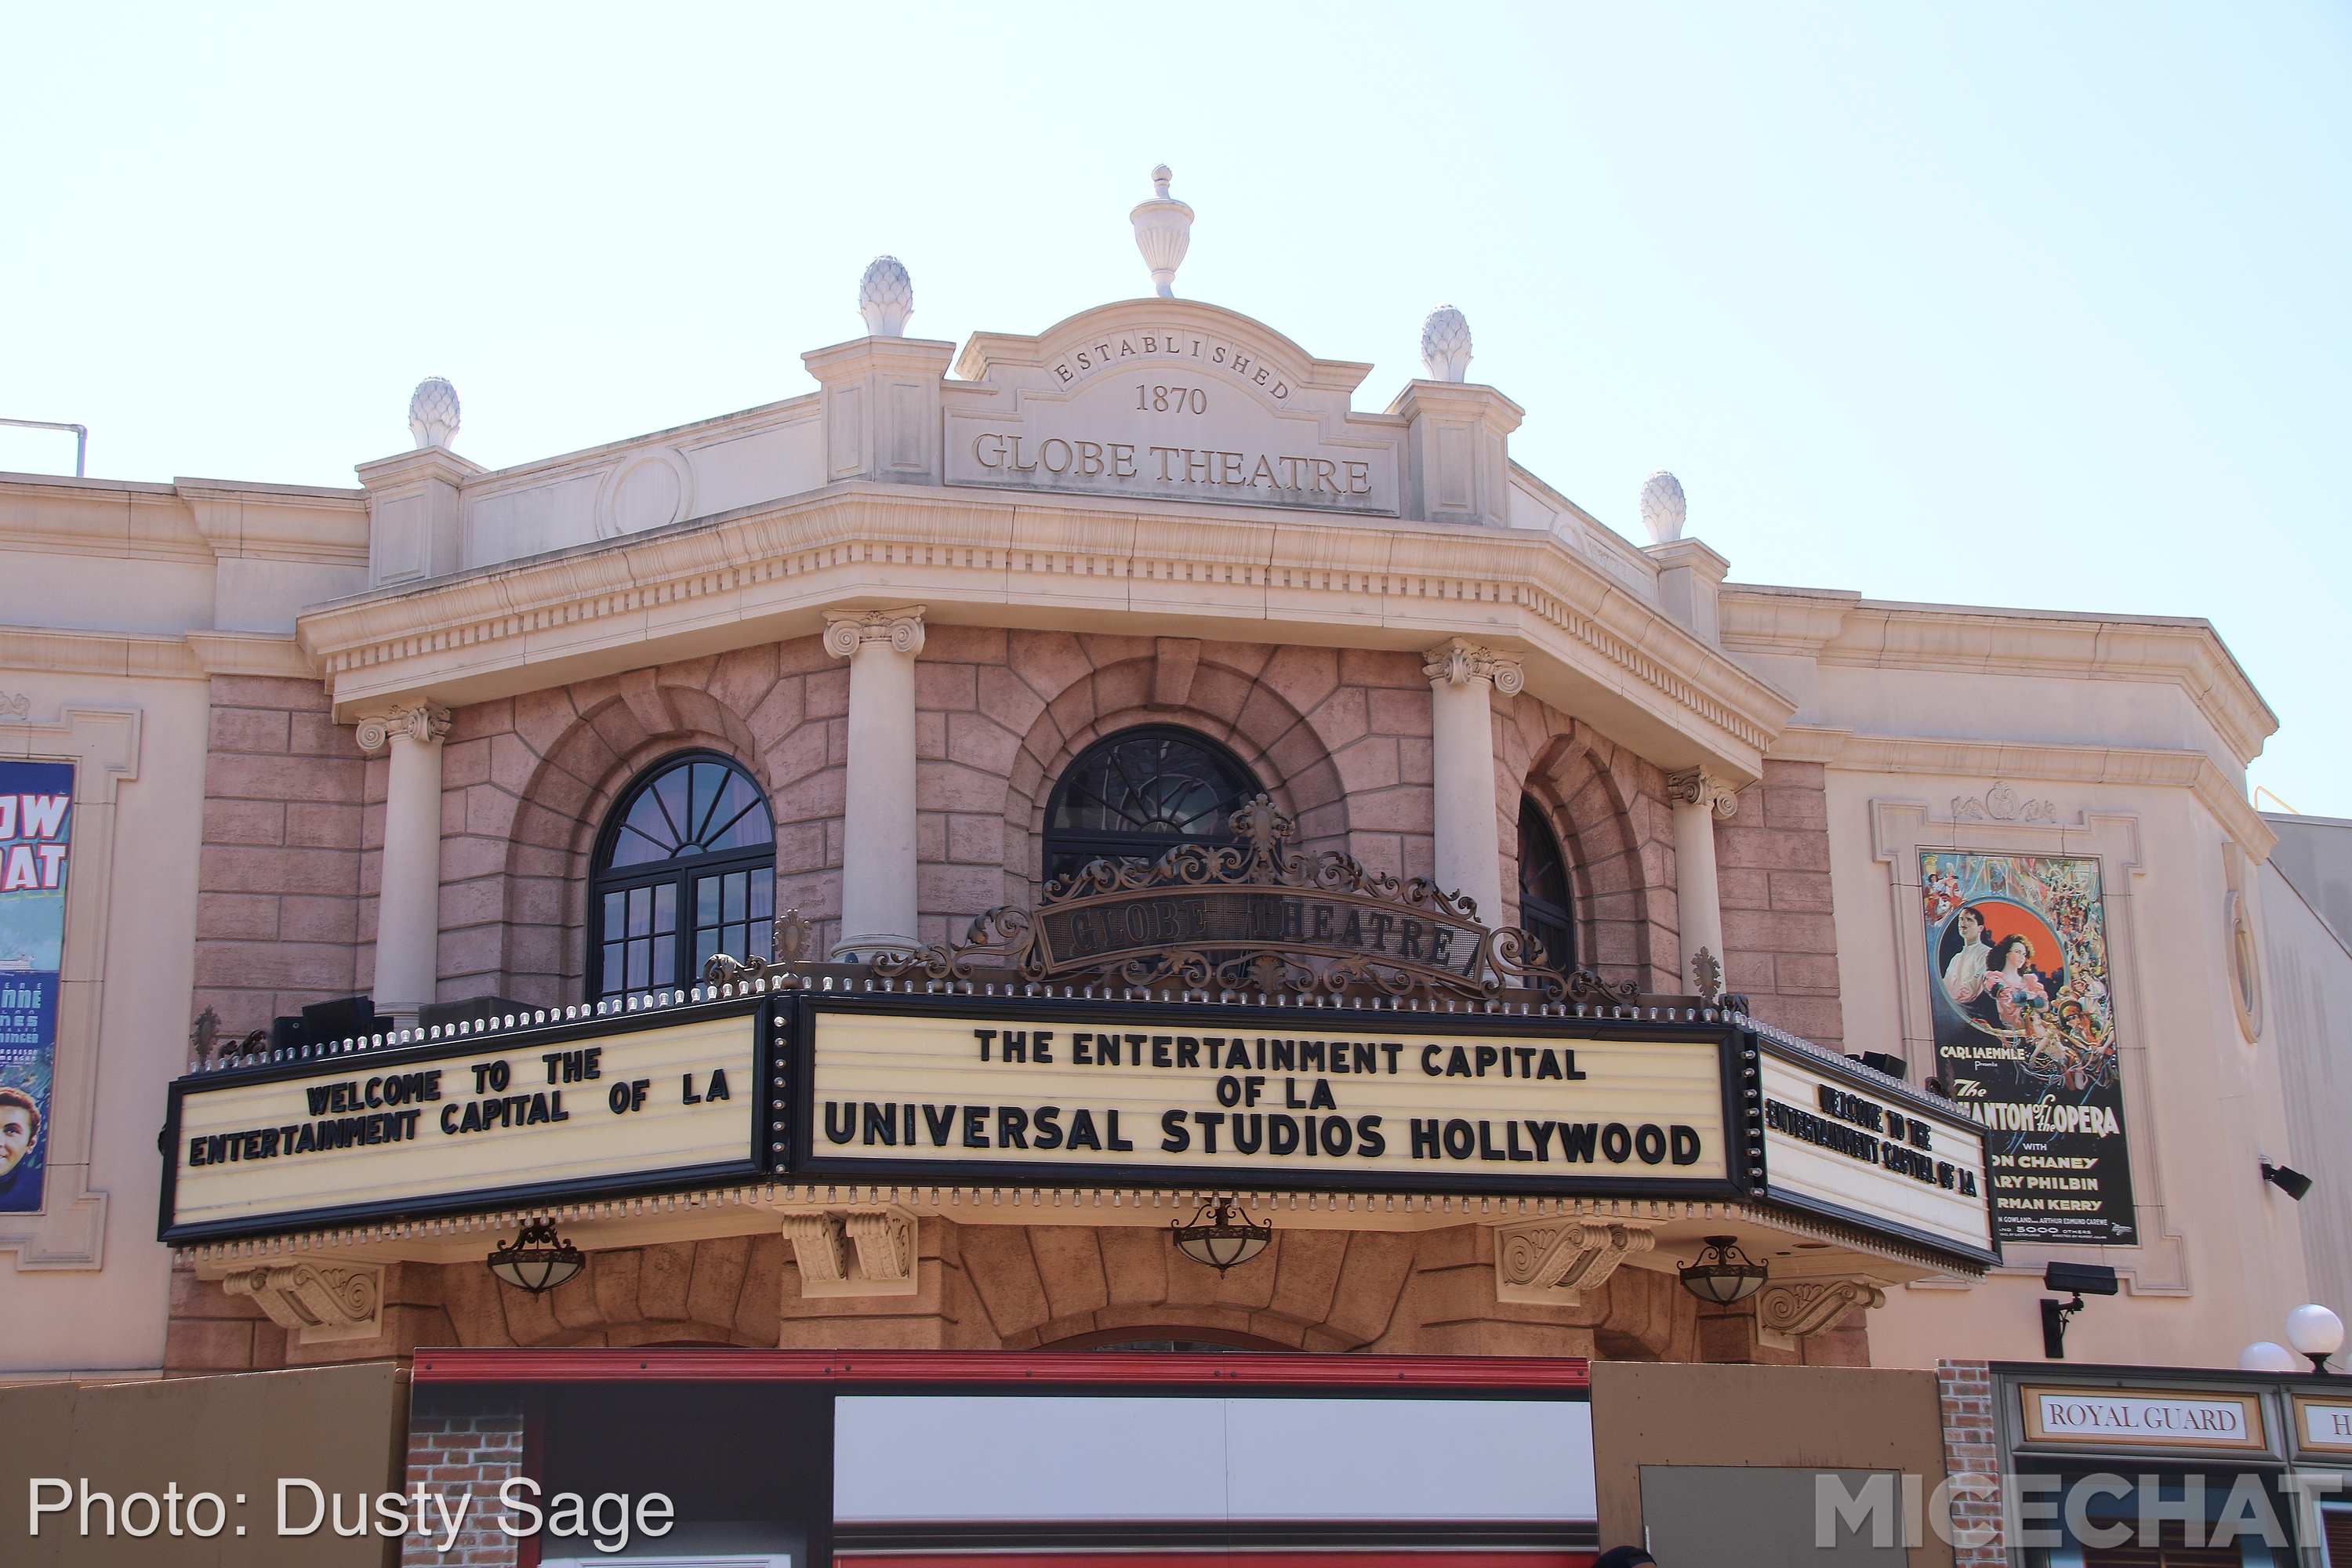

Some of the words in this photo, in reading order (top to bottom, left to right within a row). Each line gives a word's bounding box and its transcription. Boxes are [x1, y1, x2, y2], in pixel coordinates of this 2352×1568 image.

[1053, 336, 1289, 401] ESTABLISHED
[1135, 384, 1207, 415] 1870
[971, 433, 1137, 478] GLOBE
[1149, 445, 1372, 495] THEATRE
[0, 842, 68, 892] AT
[1069, 898, 1209, 953] GLOBE
[1251, 898, 1455, 966] THEATRE
[975, 1029, 1054, 1063] THE
[1073, 1033, 1403, 1075] ENTERTAINMENT
[1421, 1044, 1587, 1080] CAPITAL
[1940, 1046, 1973, 1060] CARL
[1973, 1047, 2026, 1060] LAEMMLE
[307, 1069, 442, 1117] WELCOME
[472, 1059, 510, 1094] TO
[543, 1047, 601, 1085] THE
[1217, 1075, 1265, 1107] OF
[1286, 1077, 1337, 1109] LA
[1953, 1078, 1987, 1097] The
[188, 1109, 421, 1167] ENTERTAINMENT
[440, 1090, 568, 1135] CAPITAL
[608, 1078, 650, 1114] OF
[682, 1068, 730, 1105] LA
[1818, 1083, 1883, 1134] WELCOME
[1886, 1109, 1905, 1142] TO
[1907, 1117, 1932, 1152] THE
[2033, 1094, 2056, 1120] of
[2037, 1105, 2056, 1132] the
[2053, 1105, 2120, 1138] OPERA
[825, 1101, 1133, 1152] UNIVERSAL
[1160, 1109, 1386, 1157] STUDIOS
[1411, 1118, 1701, 1166] HOLLYWOOD
[1765, 1098, 1879, 1164] ENTERTAINMENT
[1882, 1141, 1937, 1185] CAPITAL
[1939, 1160, 1955, 1190] OF
[1958, 1167, 1976, 1197] LA
[2018, 1156, 2099, 1169] CHANEY
[2027, 1177, 2098, 1191] PHILBIN
[2047, 1200, 2102, 1211] KERRY
[2049, 1402, 2139, 1428] ROYAL
[2143, 1406, 2237, 1432] GUARD
